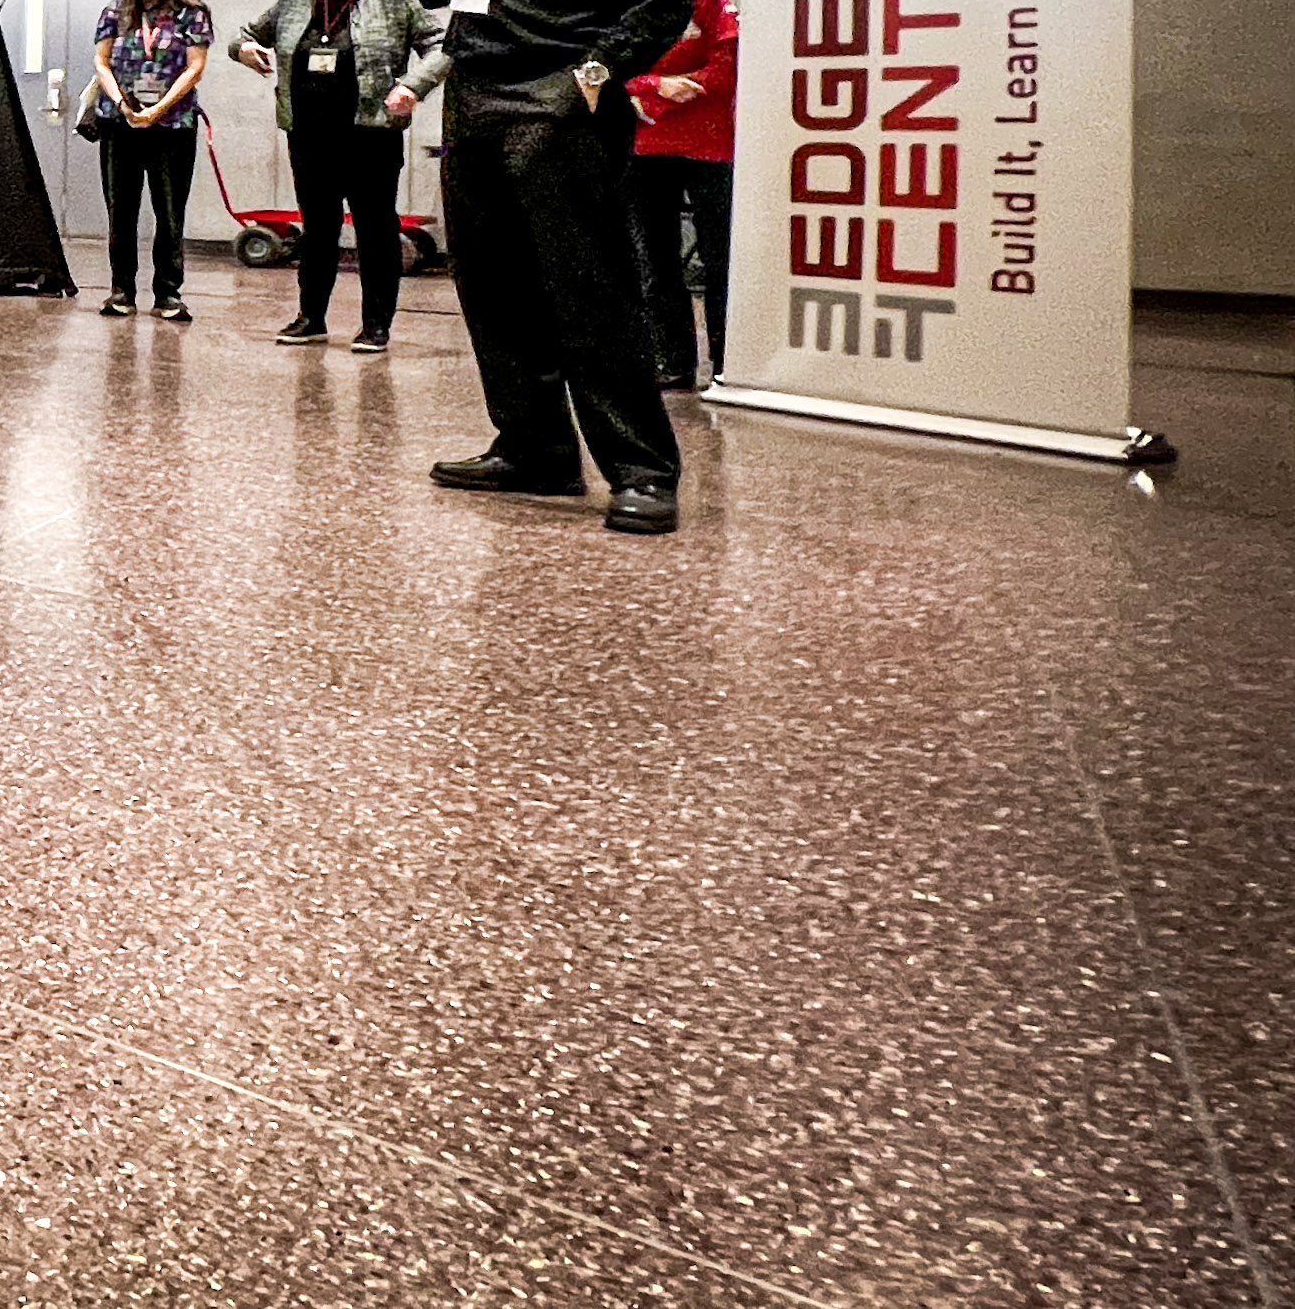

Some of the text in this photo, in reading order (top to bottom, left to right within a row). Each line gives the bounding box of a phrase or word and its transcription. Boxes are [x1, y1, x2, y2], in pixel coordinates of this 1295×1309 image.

[995, 7, 1039, 123] Learn
[994, 140, 1044, 175] It,
[991, 192, 1036, 294] Build
